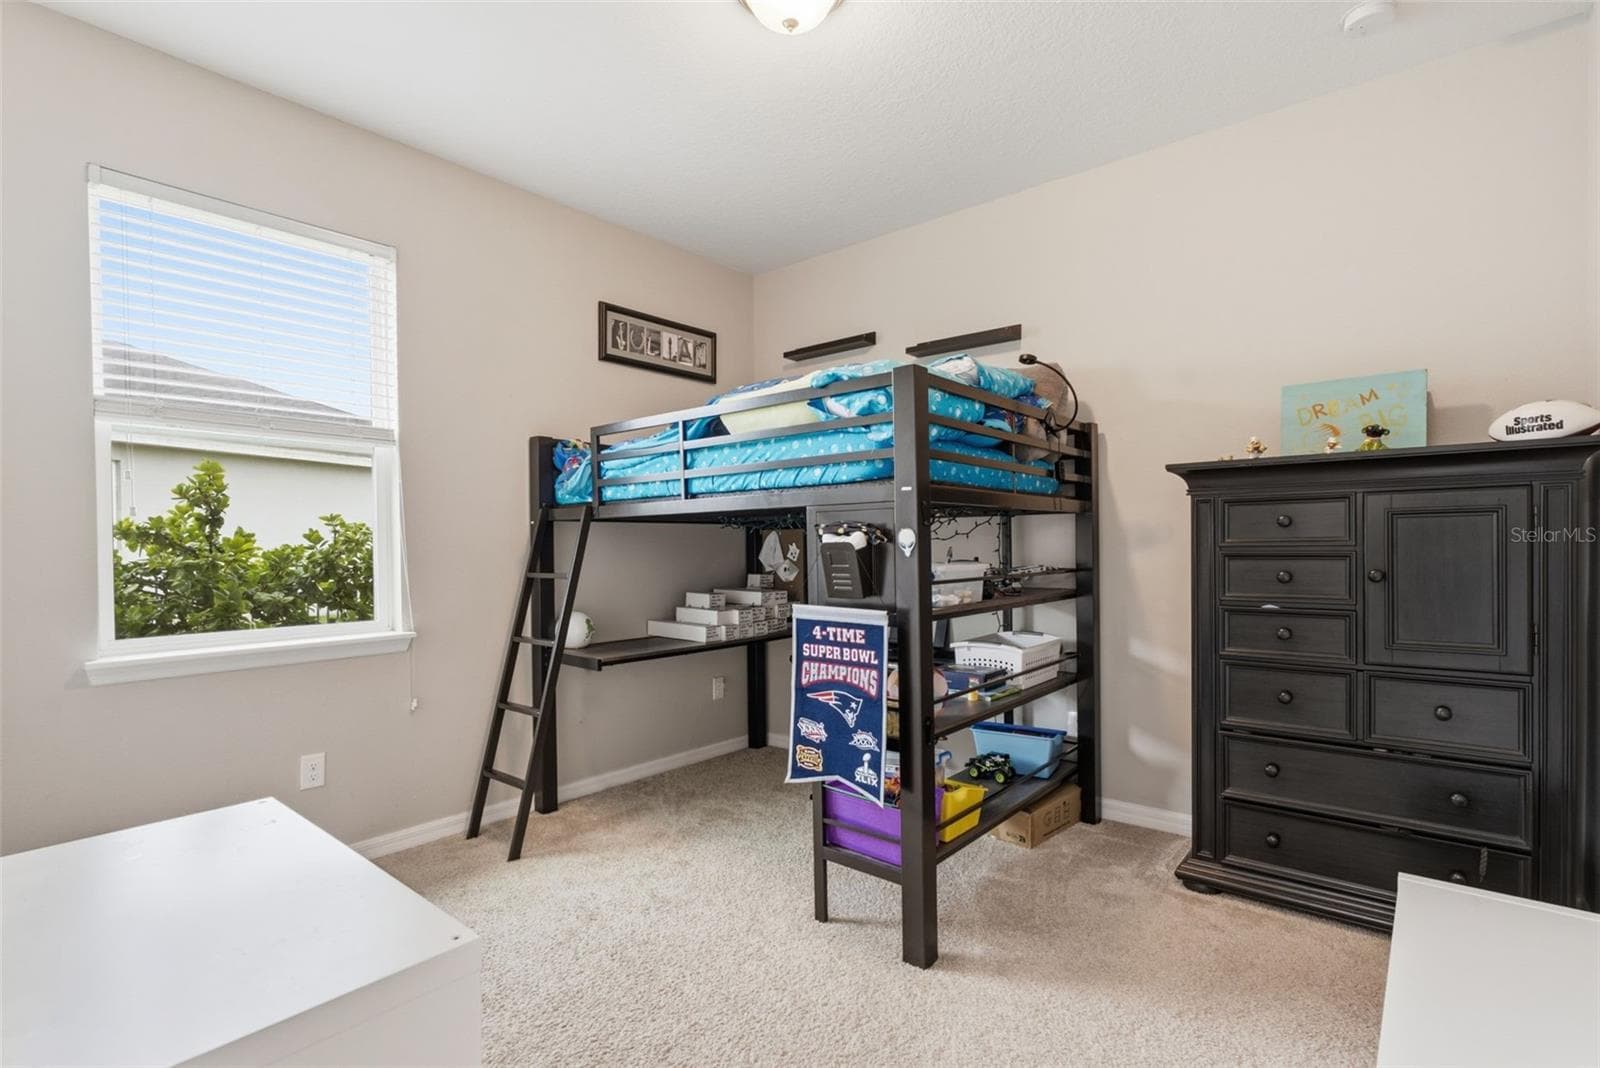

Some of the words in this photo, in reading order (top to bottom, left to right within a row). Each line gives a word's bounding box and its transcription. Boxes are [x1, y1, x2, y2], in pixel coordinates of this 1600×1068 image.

[1505, 420, 1564, 436] Illustrated
[1513, 414, 1553, 427] Sports
[812, 625, 866, 644] 4-TIME
[802, 643, 842, 660] SUPER
[843, 647, 879, 665] BOWL
[801, 661, 879, 697] CHAMPIONS
